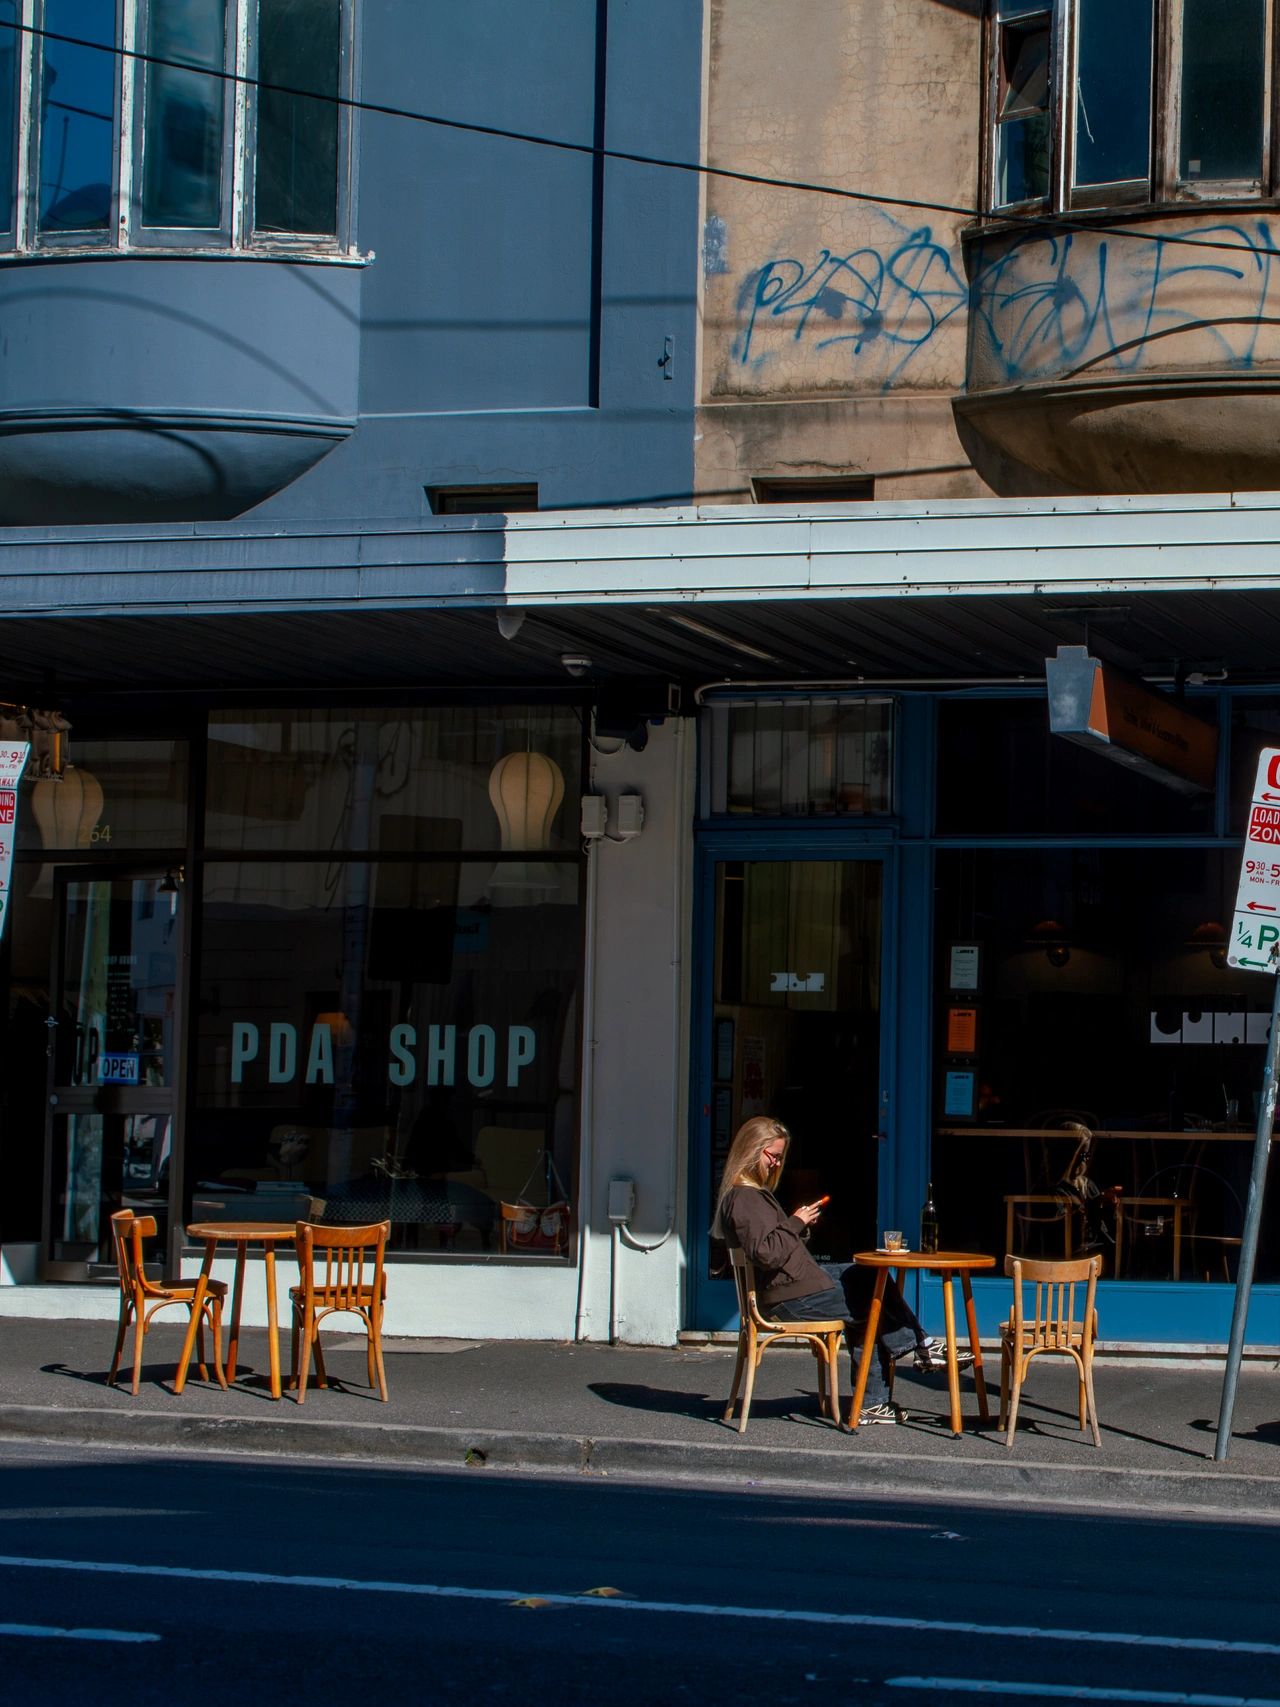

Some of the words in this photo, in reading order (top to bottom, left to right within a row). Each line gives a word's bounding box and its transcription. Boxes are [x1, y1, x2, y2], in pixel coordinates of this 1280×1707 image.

[79, 824, 112, 842] 264
[1257, 925, 1280, 950] P
[230, 1021, 335, 1085] PDA
[388, 1023, 537, 1088] SHOP
[103, 1058, 135, 1079] OPEN
